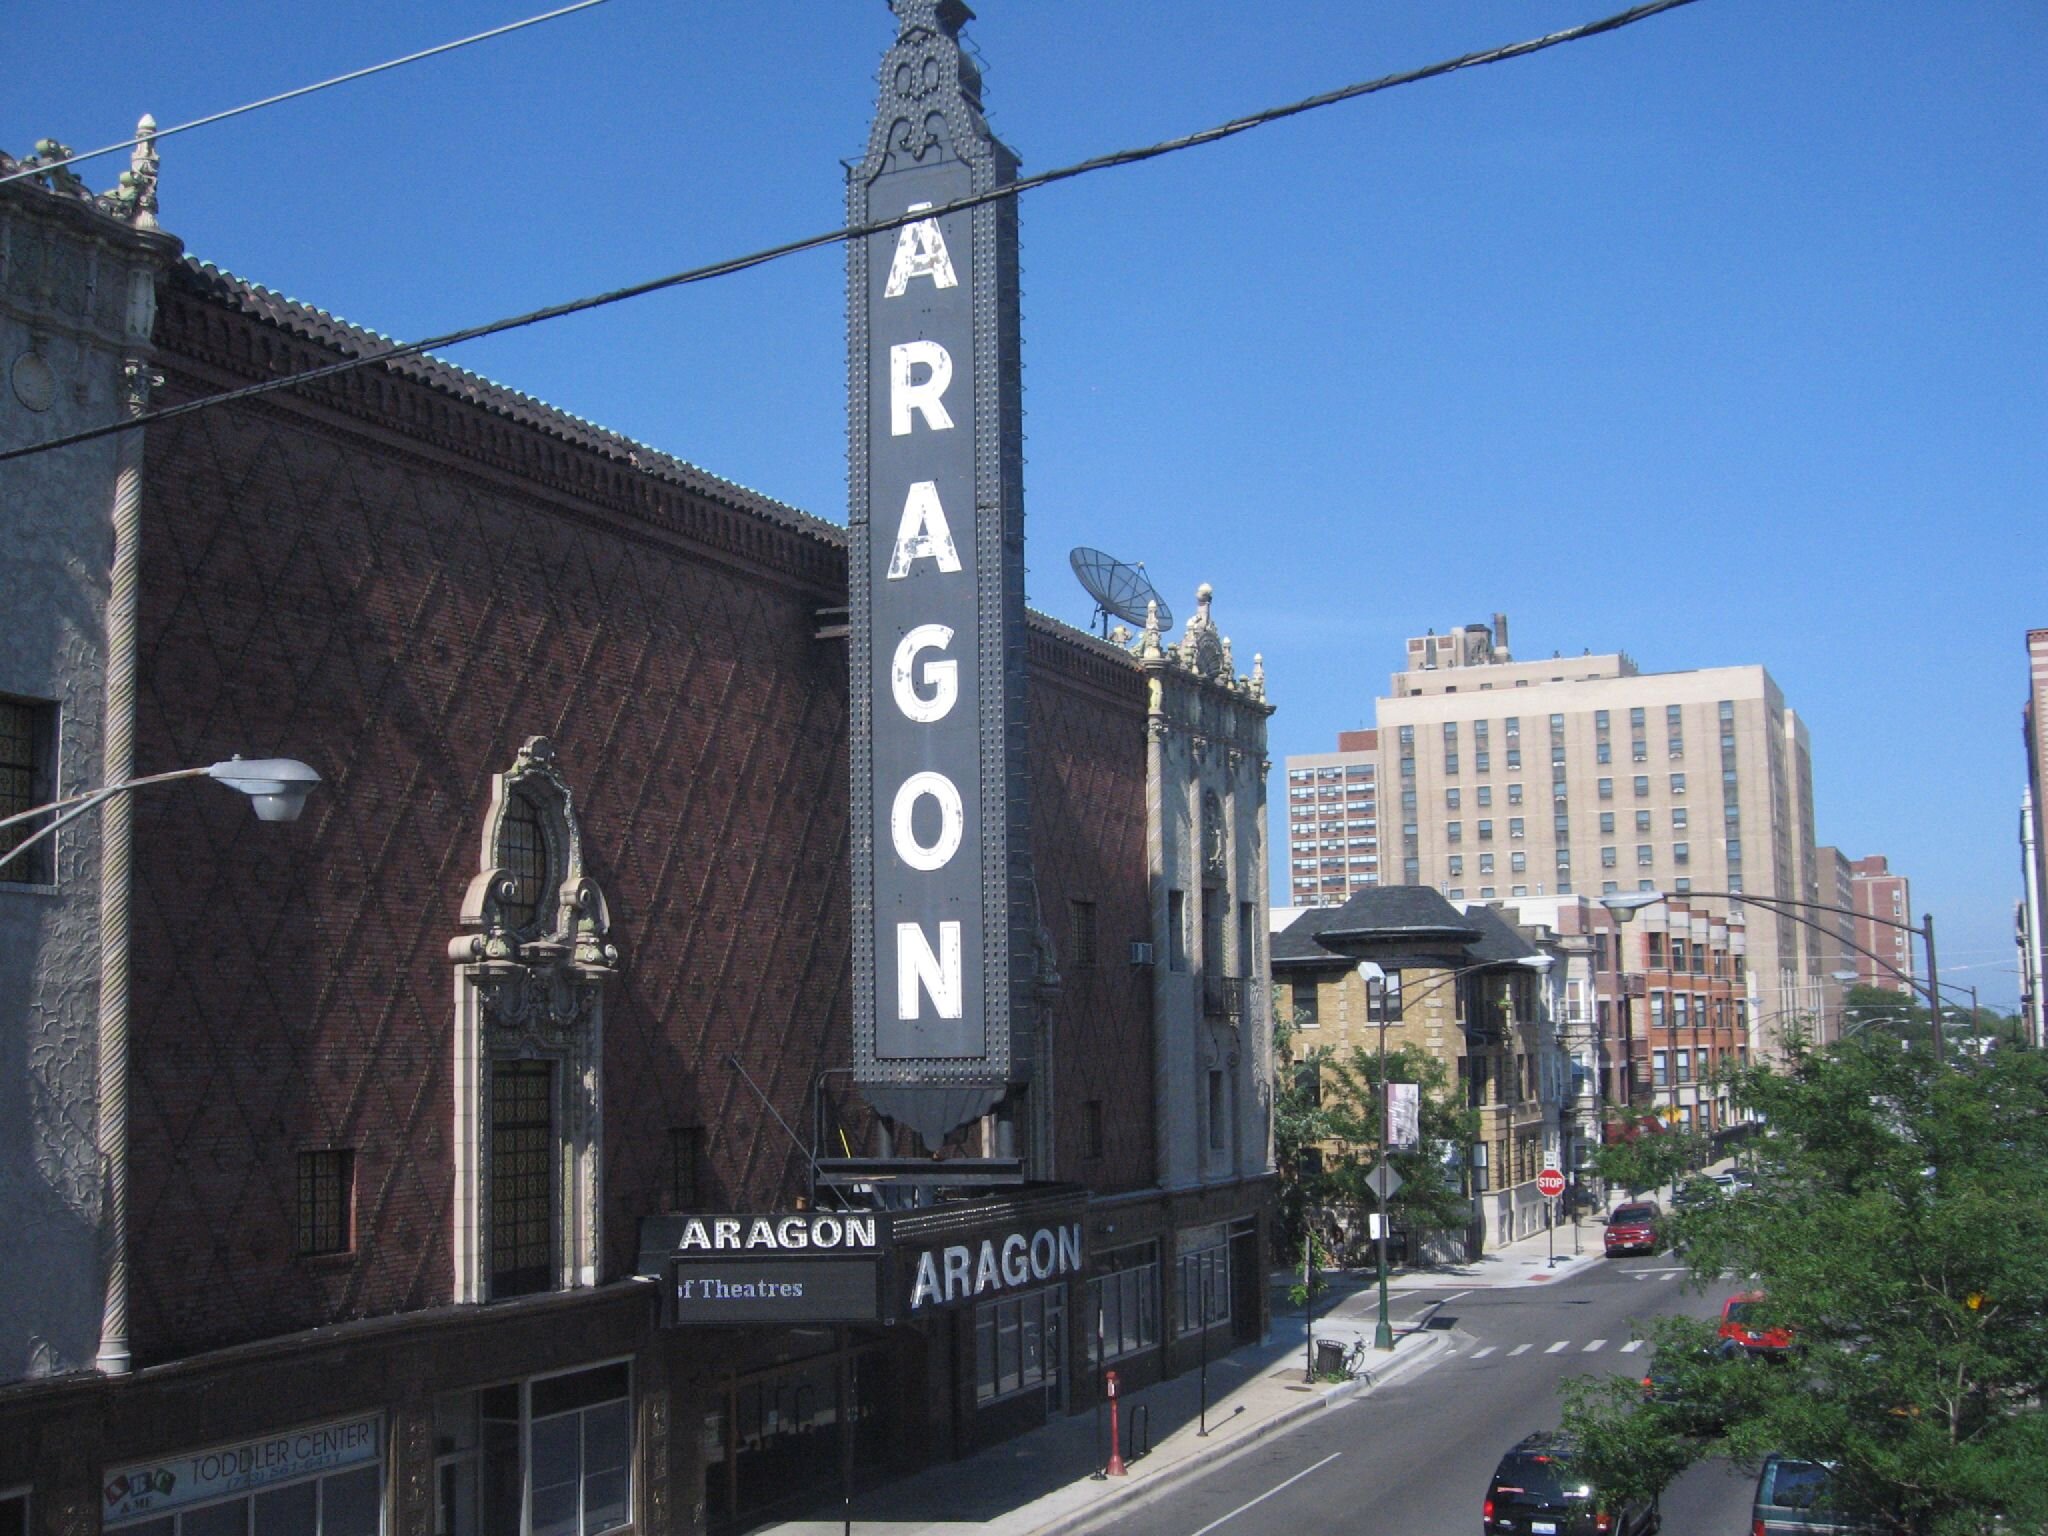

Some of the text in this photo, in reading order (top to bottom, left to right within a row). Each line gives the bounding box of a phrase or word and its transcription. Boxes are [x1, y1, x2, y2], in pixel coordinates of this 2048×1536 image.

[884, 202, 964, 1020] ARAGON
[1539, 1177, 1562, 1188] STOP
[678, 1216, 876, 1249] ARAGON
[699, 1279, 803, 1298] Theatres
[910, 1223, 1082, 1308] ARAGON
[191, 1423, 369, 1484] TODDLER CENTER
